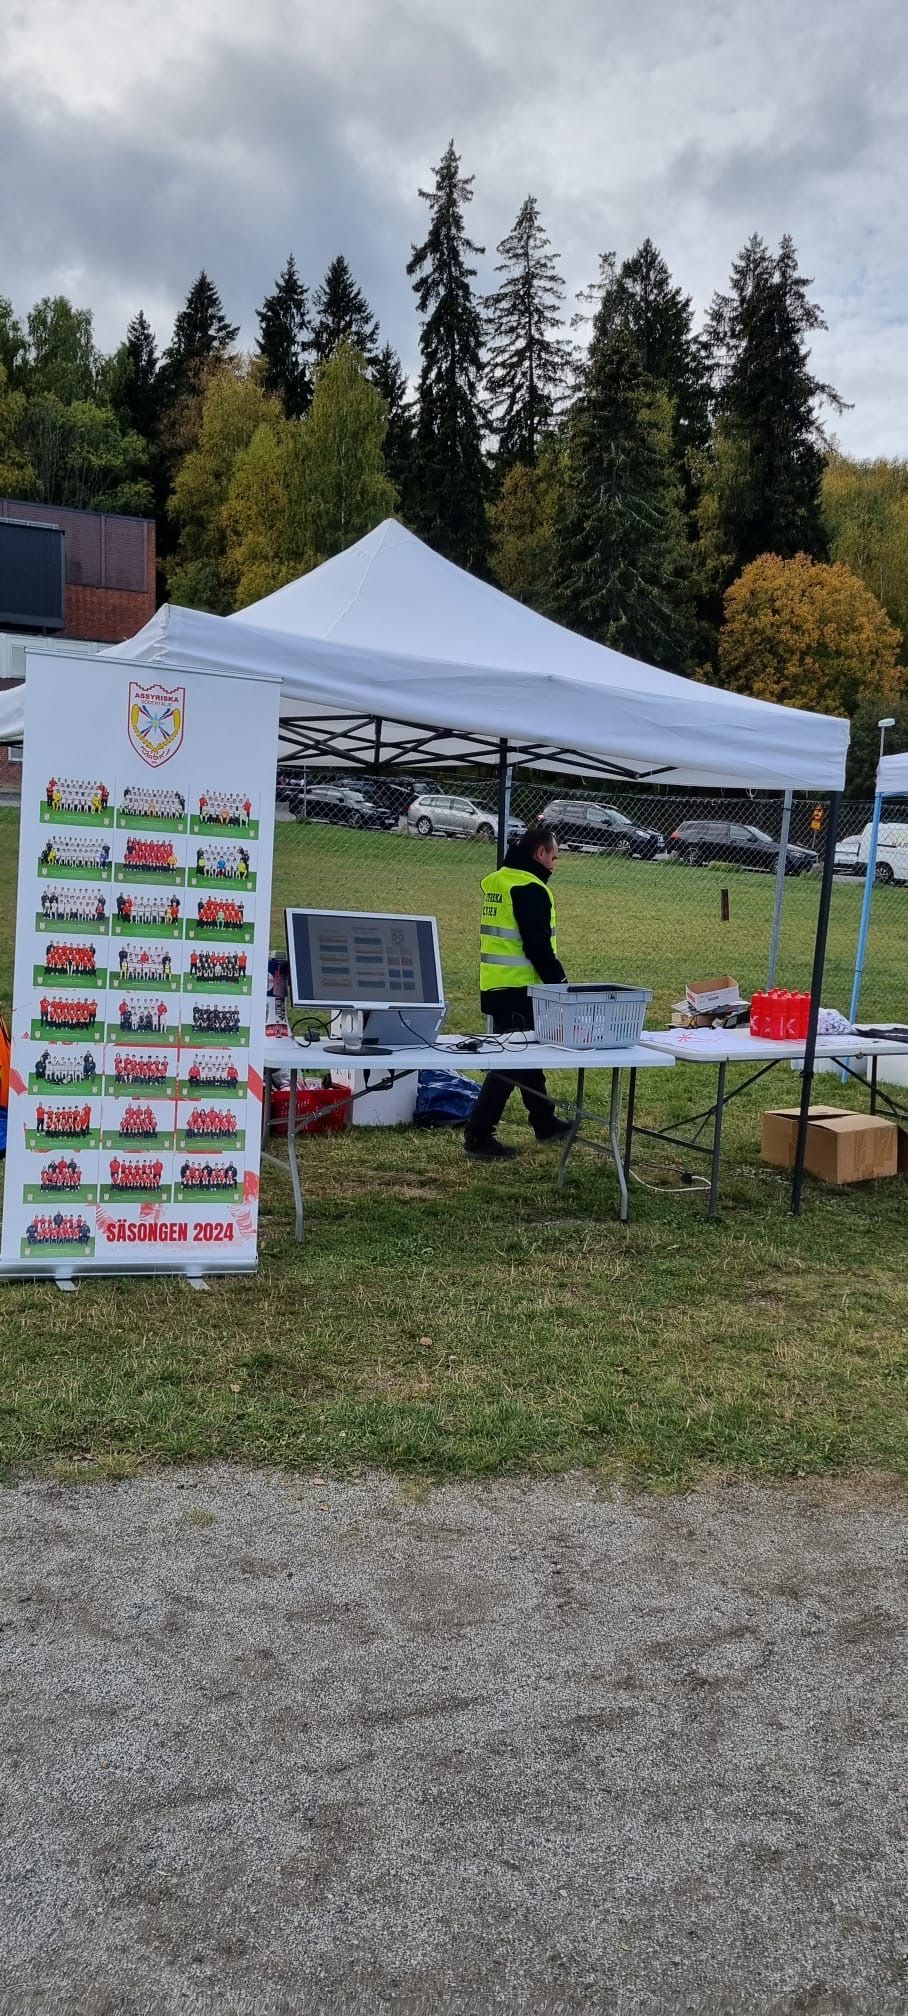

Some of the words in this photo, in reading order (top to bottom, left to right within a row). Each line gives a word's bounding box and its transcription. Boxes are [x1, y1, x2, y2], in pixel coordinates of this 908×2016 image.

[135, 692, 179, 702] ASSYRISKA
[106, 1219, 187, 1242] SÄSONGEN
[193, 1222, 234, 1242] 2024
